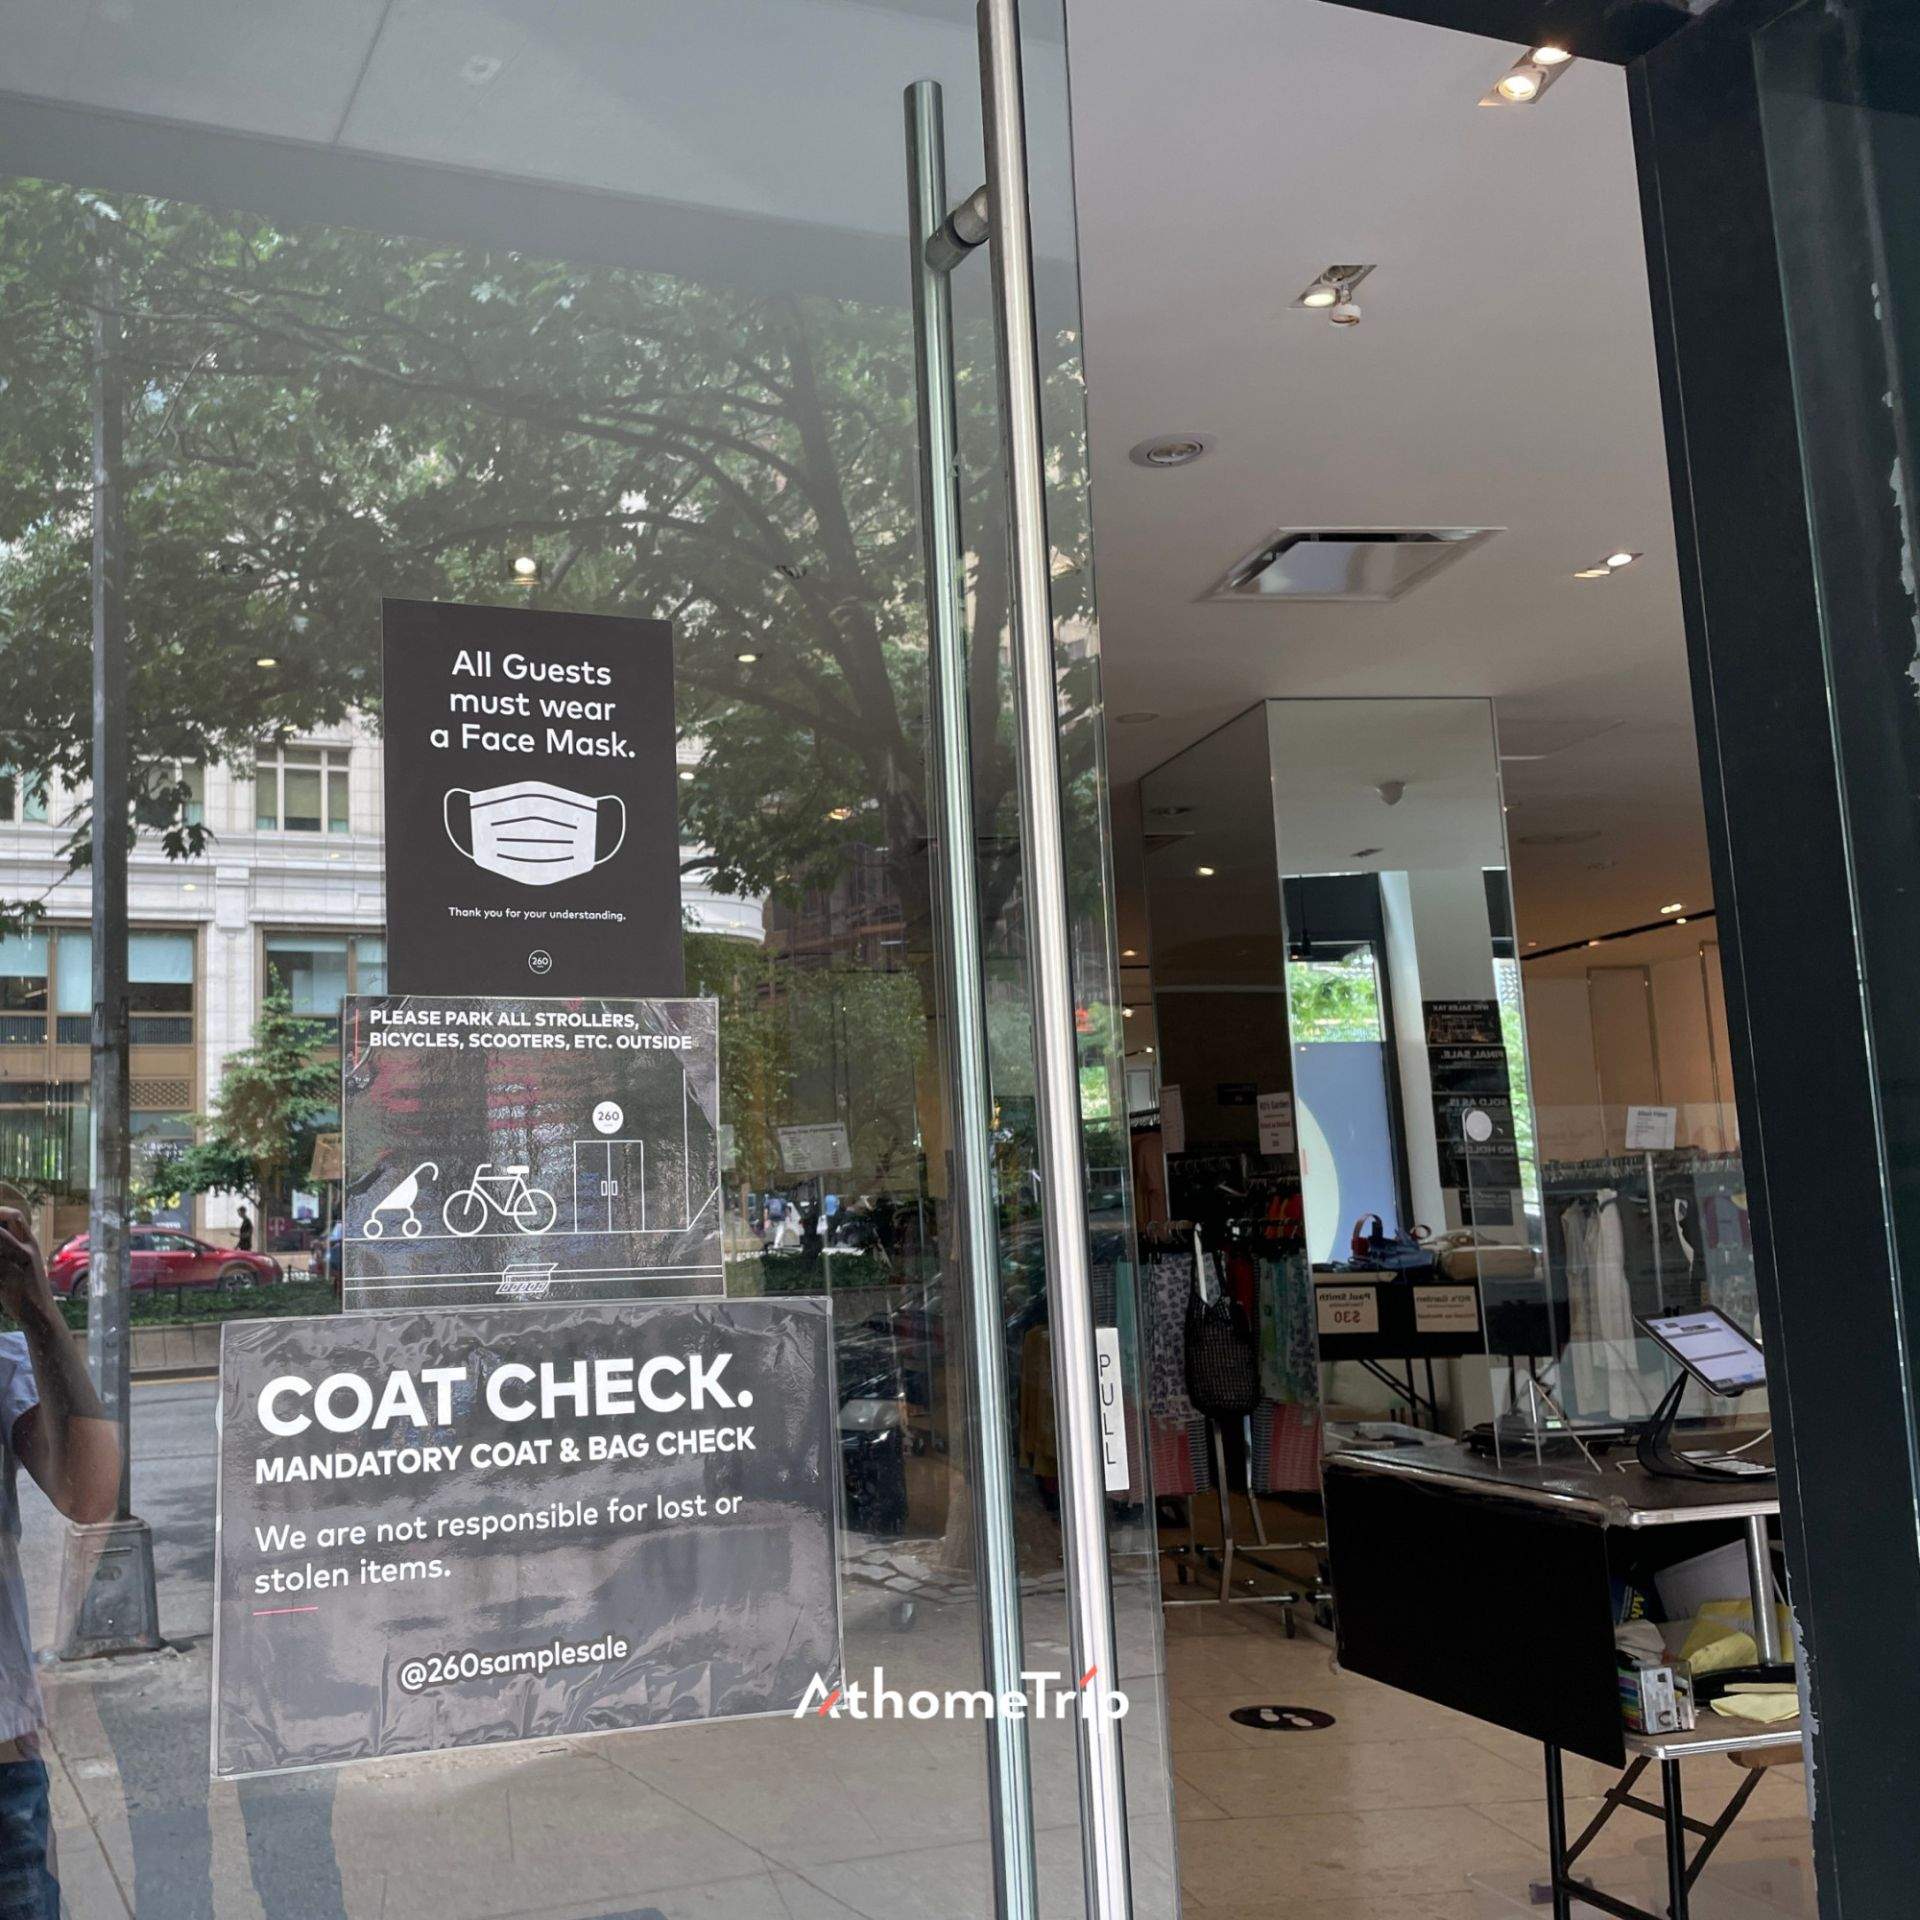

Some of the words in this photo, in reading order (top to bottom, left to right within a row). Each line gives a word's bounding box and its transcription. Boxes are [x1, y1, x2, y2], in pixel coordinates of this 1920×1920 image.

[452, 650, 491, 677] All
[503, 653, 611, 686] Guests
[450, 692, 530, 716] must
[539, 698, 615, 721] wear
[430, 728, 448, 748] a
[462, 724, 535, 752] Face
[547, 728, 635, 758] Mask.
[449, 907, 481, 917] Thank
[484, 910, 503, 920] you
[505, 908, 521, 917] for
[524, 910, 547, 921] your
[549, 909, 626, 922] understanding.
[532, 957, 548, 966] 260
[370, 1010, 441, 1025] PLEASE
[445, 1011, 493, 1026] PARK
[498, 1012, 531, 1026] ALL
[535, 1013, 639, 1030] STROLLERS,
[370, 1032, 464, 1049] BICYCLES,
[469, 1033, 570, 1050] SCOOTERS,
[575, 1035, 612, 1049] ETC.
[617, 1035, 692, 1050] OUTSIDE
[598, 1111, 619, 1121] 260
[257, 1366, 466, 1437] COAT
[485, 1353, 754, 1422] CHECK.
[1099, 1354, 1117, 1465] PULL
[255, 1445, 463, 1485] MANDATORY
[470, 1439, 552, 1468] COAT
[560, 1438, 581, 1462] &
[589, 1433, 649, 1461] BAG
[656, 1426, 756, 1456] CHECK
[255, 1525, 306, 1552] We
[317, 1525, 366, 1547] are
[377, 1516, 427, 1543] not
[438, 1502, 598, 1541] responsible
[608, 1498, 647, 1524] for
[657, 1494, 707, 1519] lost
[715, 1496, 742, 1515] or
[254, 1563, 349, 1594] stolen
[360, 1558, 451, 1585] items.
[401, 1636, 628, 1691] @260samplesale
